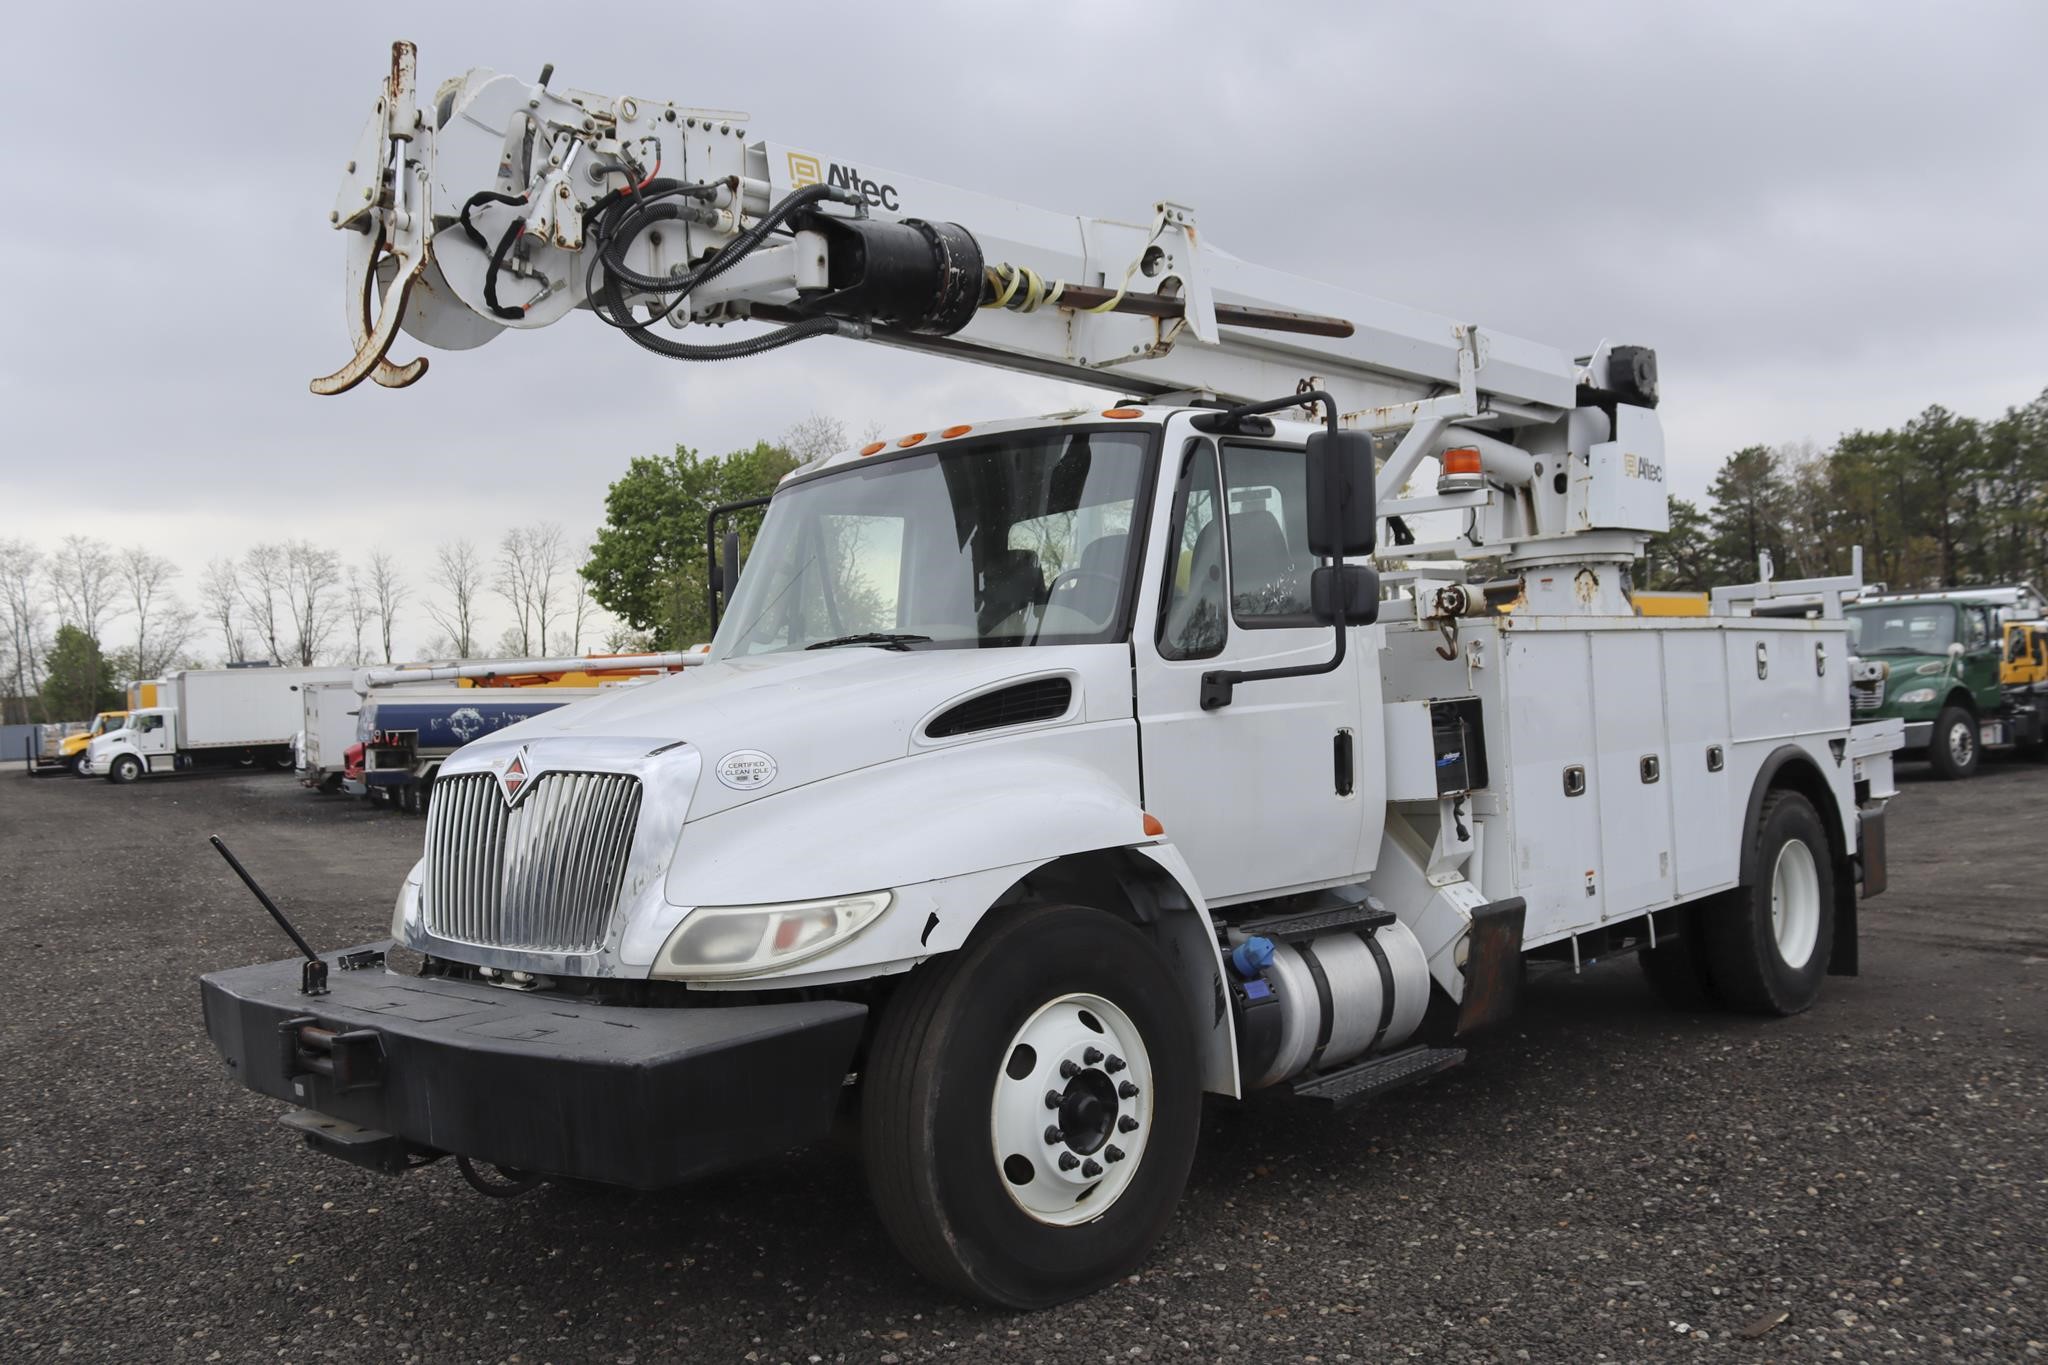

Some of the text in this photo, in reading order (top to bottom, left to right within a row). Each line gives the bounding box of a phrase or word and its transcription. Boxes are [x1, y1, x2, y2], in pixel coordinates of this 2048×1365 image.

[827, 162, 900, 212] Altec
[1637, 455, 1663, 483] Altec
[728, 761, 765, 769] CERTIFIED
